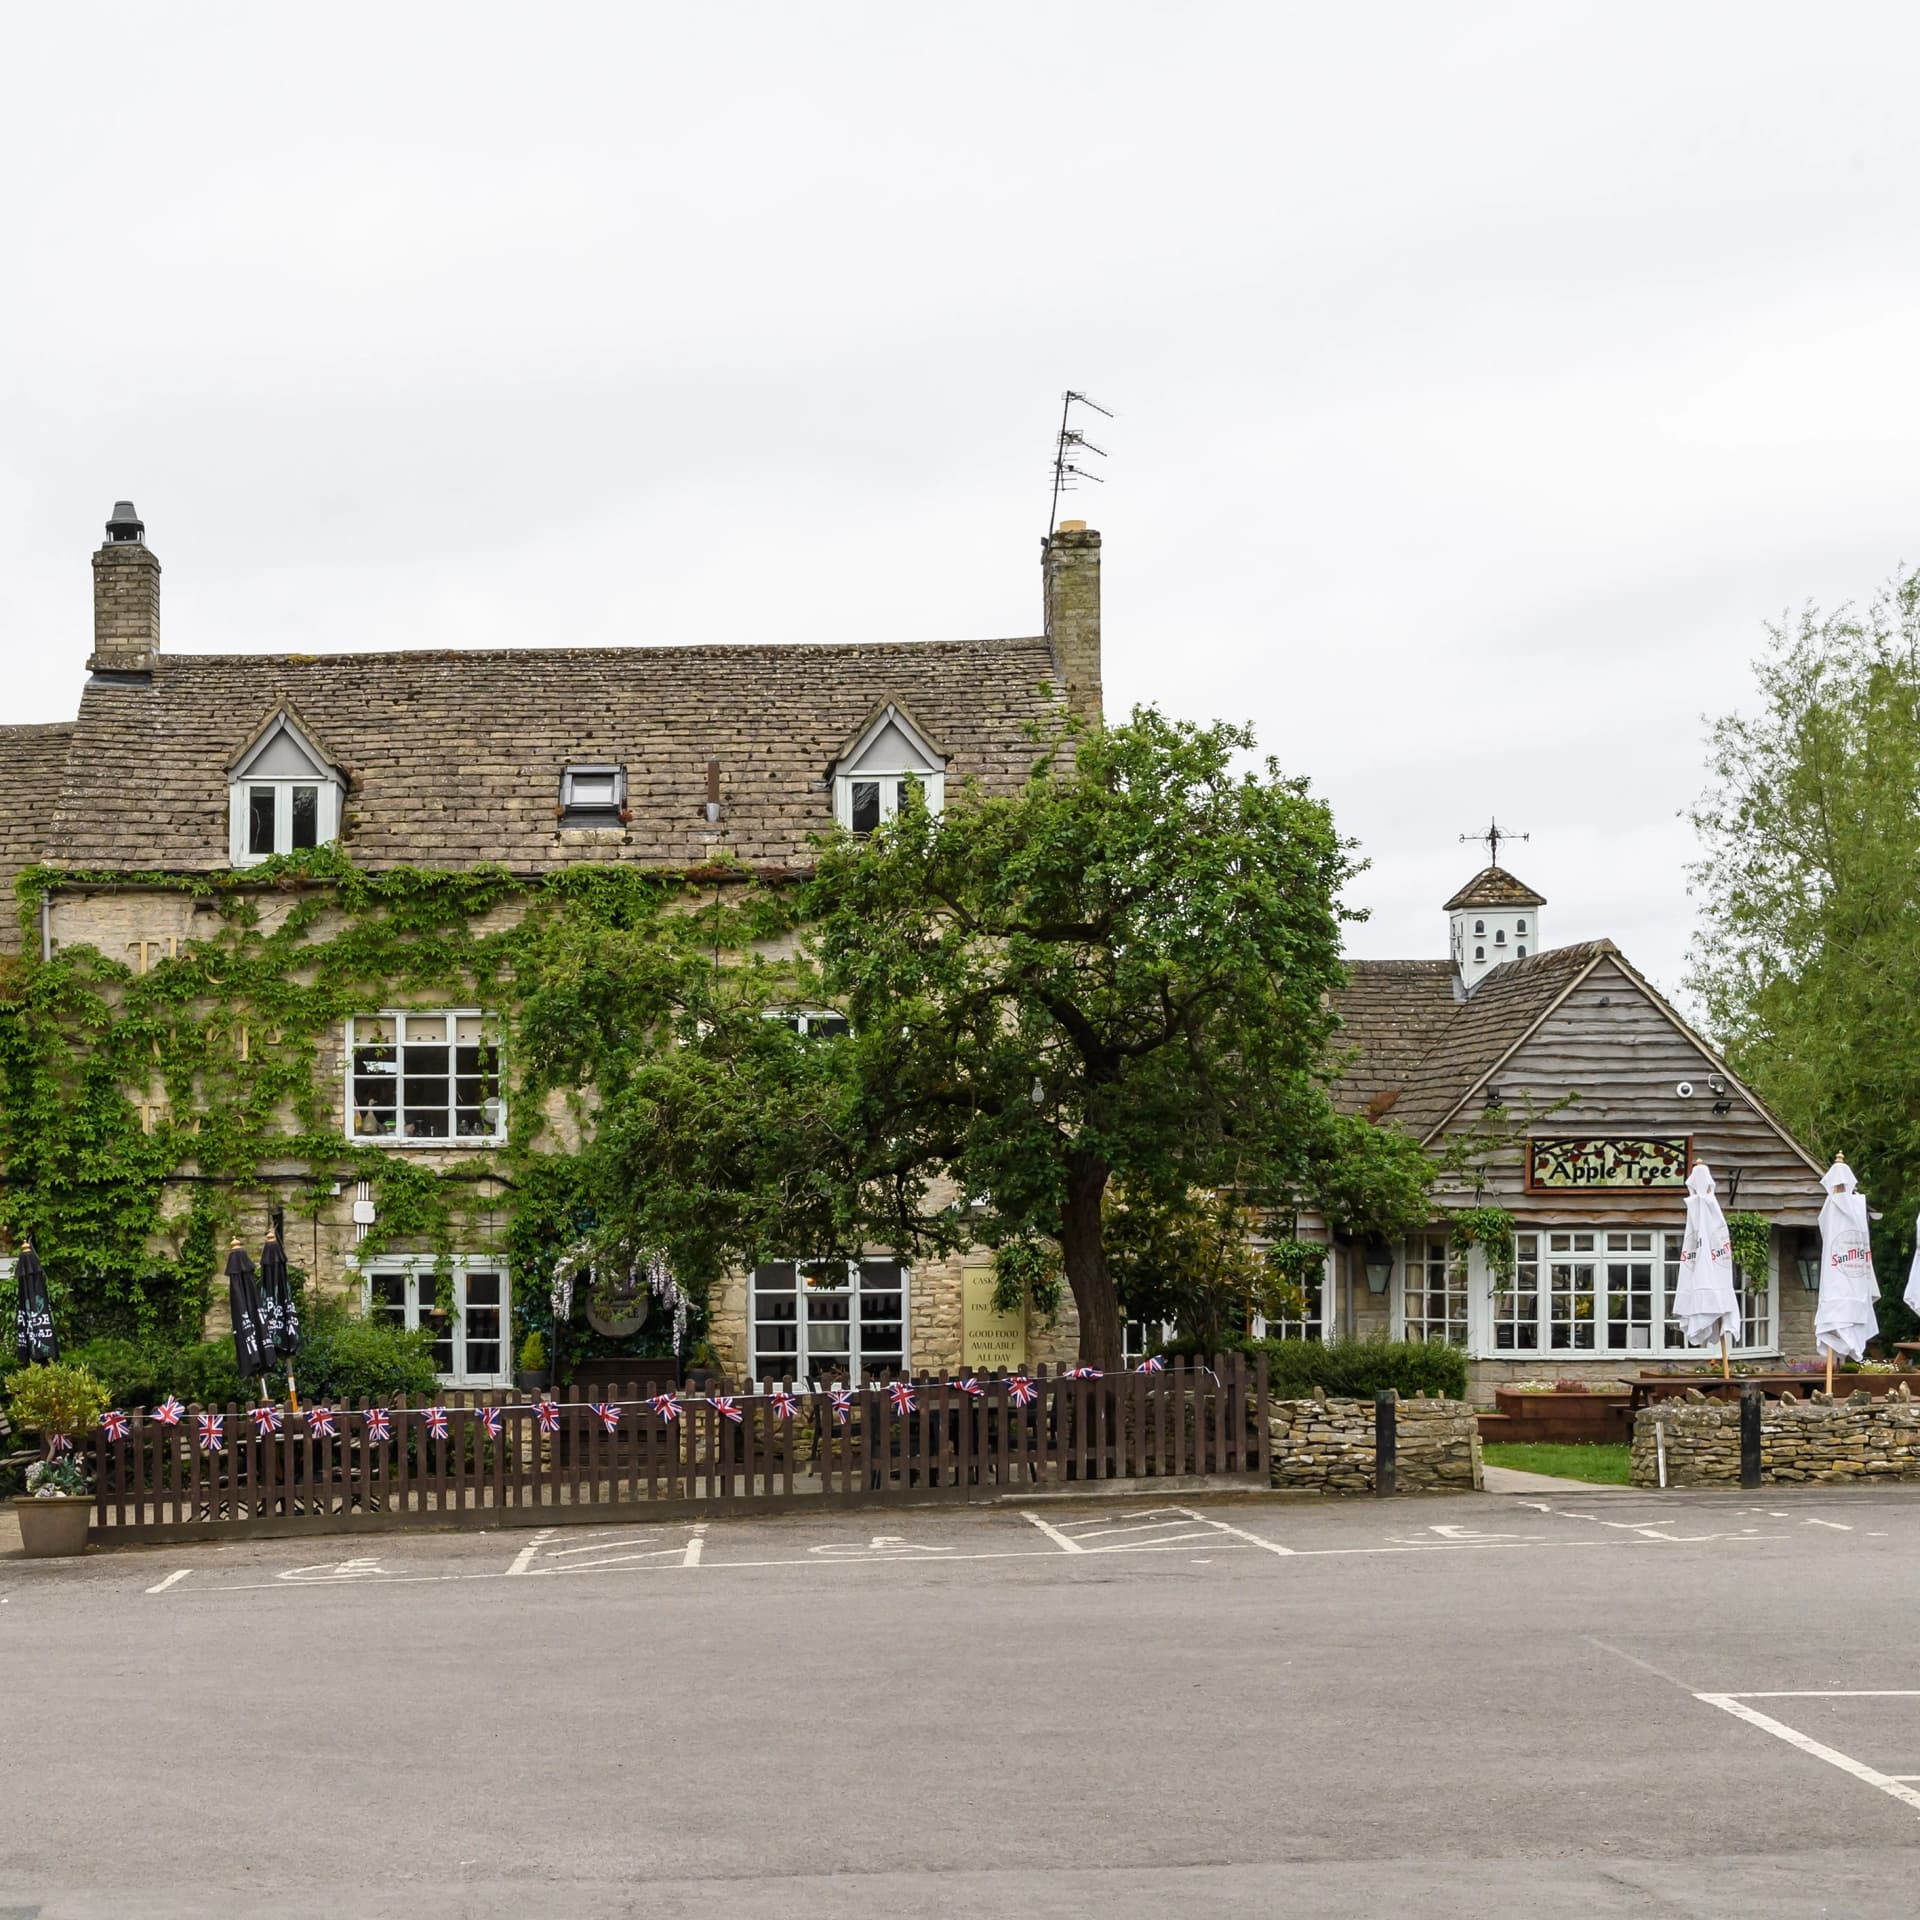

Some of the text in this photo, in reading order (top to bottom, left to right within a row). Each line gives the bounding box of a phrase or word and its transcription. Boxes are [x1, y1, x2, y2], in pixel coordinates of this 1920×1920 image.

[1548, 1161, 1672, 1184] Apple Tree
[972, 1277, 993, 1285] CASK
[968, 1330, 1019, 1338] GOOD FOOD
[971, 1342, 1016, 1350] AVAILABLE
[977, 1353, 1011, 1361] ALL DAY
